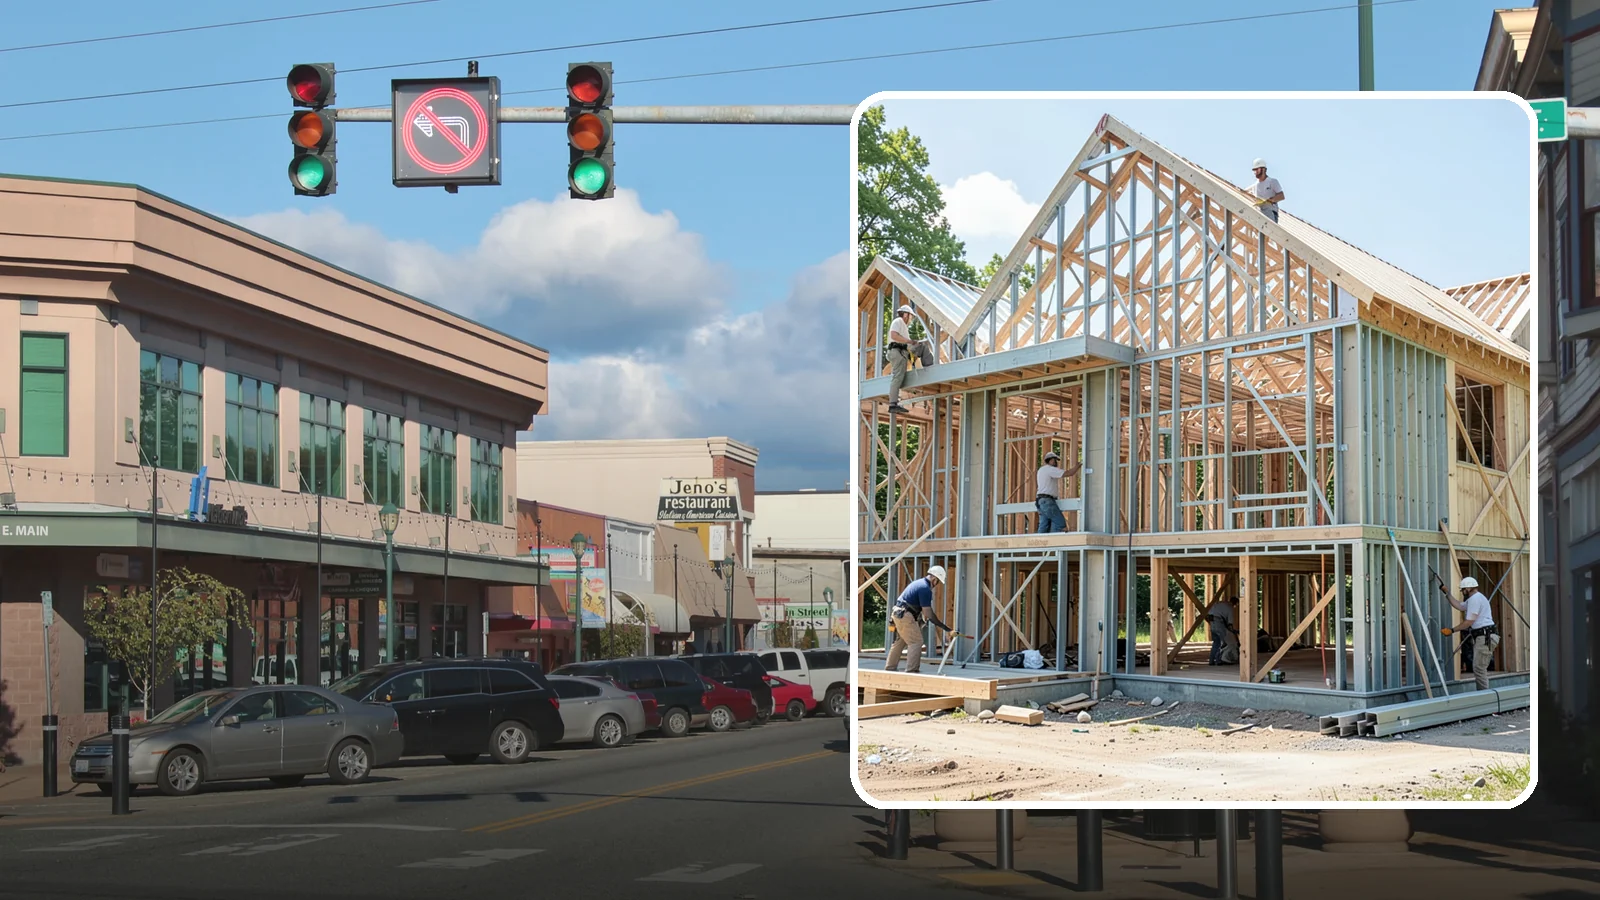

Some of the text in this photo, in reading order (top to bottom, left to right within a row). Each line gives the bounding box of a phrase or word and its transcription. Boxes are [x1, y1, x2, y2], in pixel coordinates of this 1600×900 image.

[669, 480, 727, 494] Jeno's
[665, 496, 731, 509] restaurant
[658, 510, 682, 519] Italian
[686, 509, 714, 519] American
[715, 509, 737, 519] Cuisine
[2, 525, 49, 536] E. MAIN
[797, 607, 828, 616] Street
